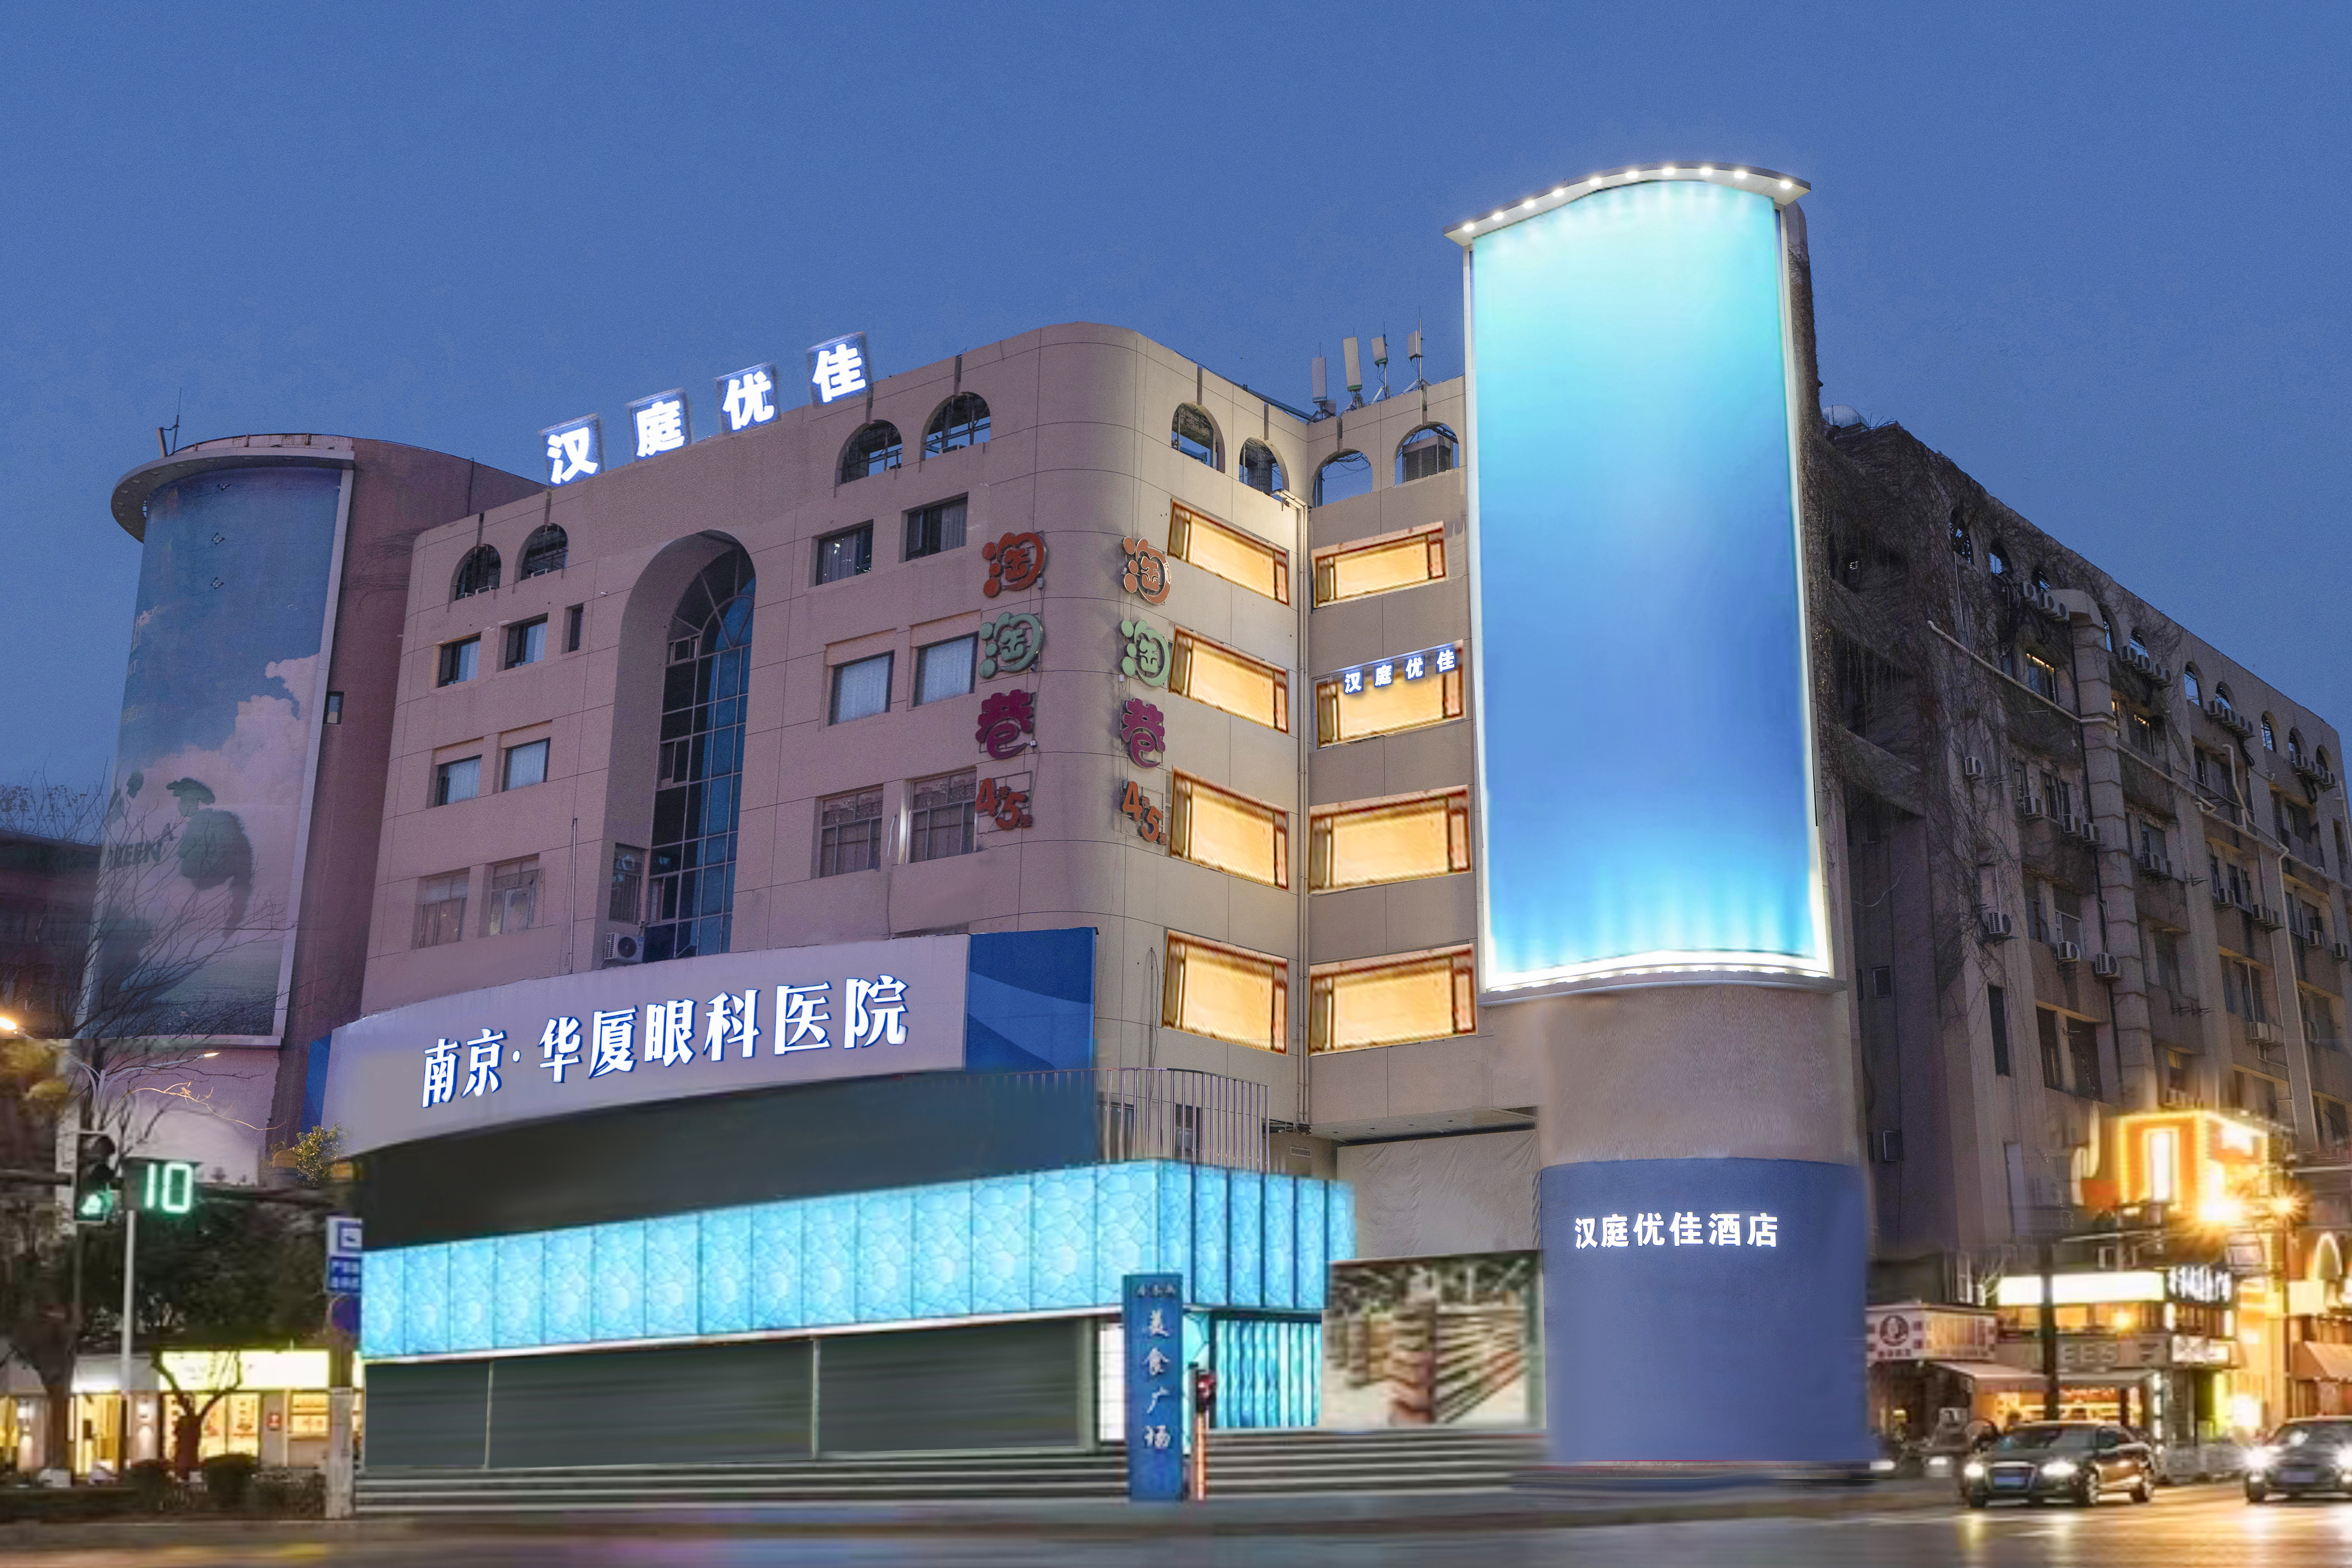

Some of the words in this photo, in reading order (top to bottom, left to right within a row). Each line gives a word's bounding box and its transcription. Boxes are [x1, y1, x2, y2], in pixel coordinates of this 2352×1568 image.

[546, 344, 866, 484] 汉庭优佳
[1344, 650, 1455, 693] 汉庭优佳
[422, 975, 909, 1108] 南京·华厦眼科医院
[144, 1163, 193, 1213] 10
[1575, 1212, 1779, 1249] 汉庭优佳酒店
